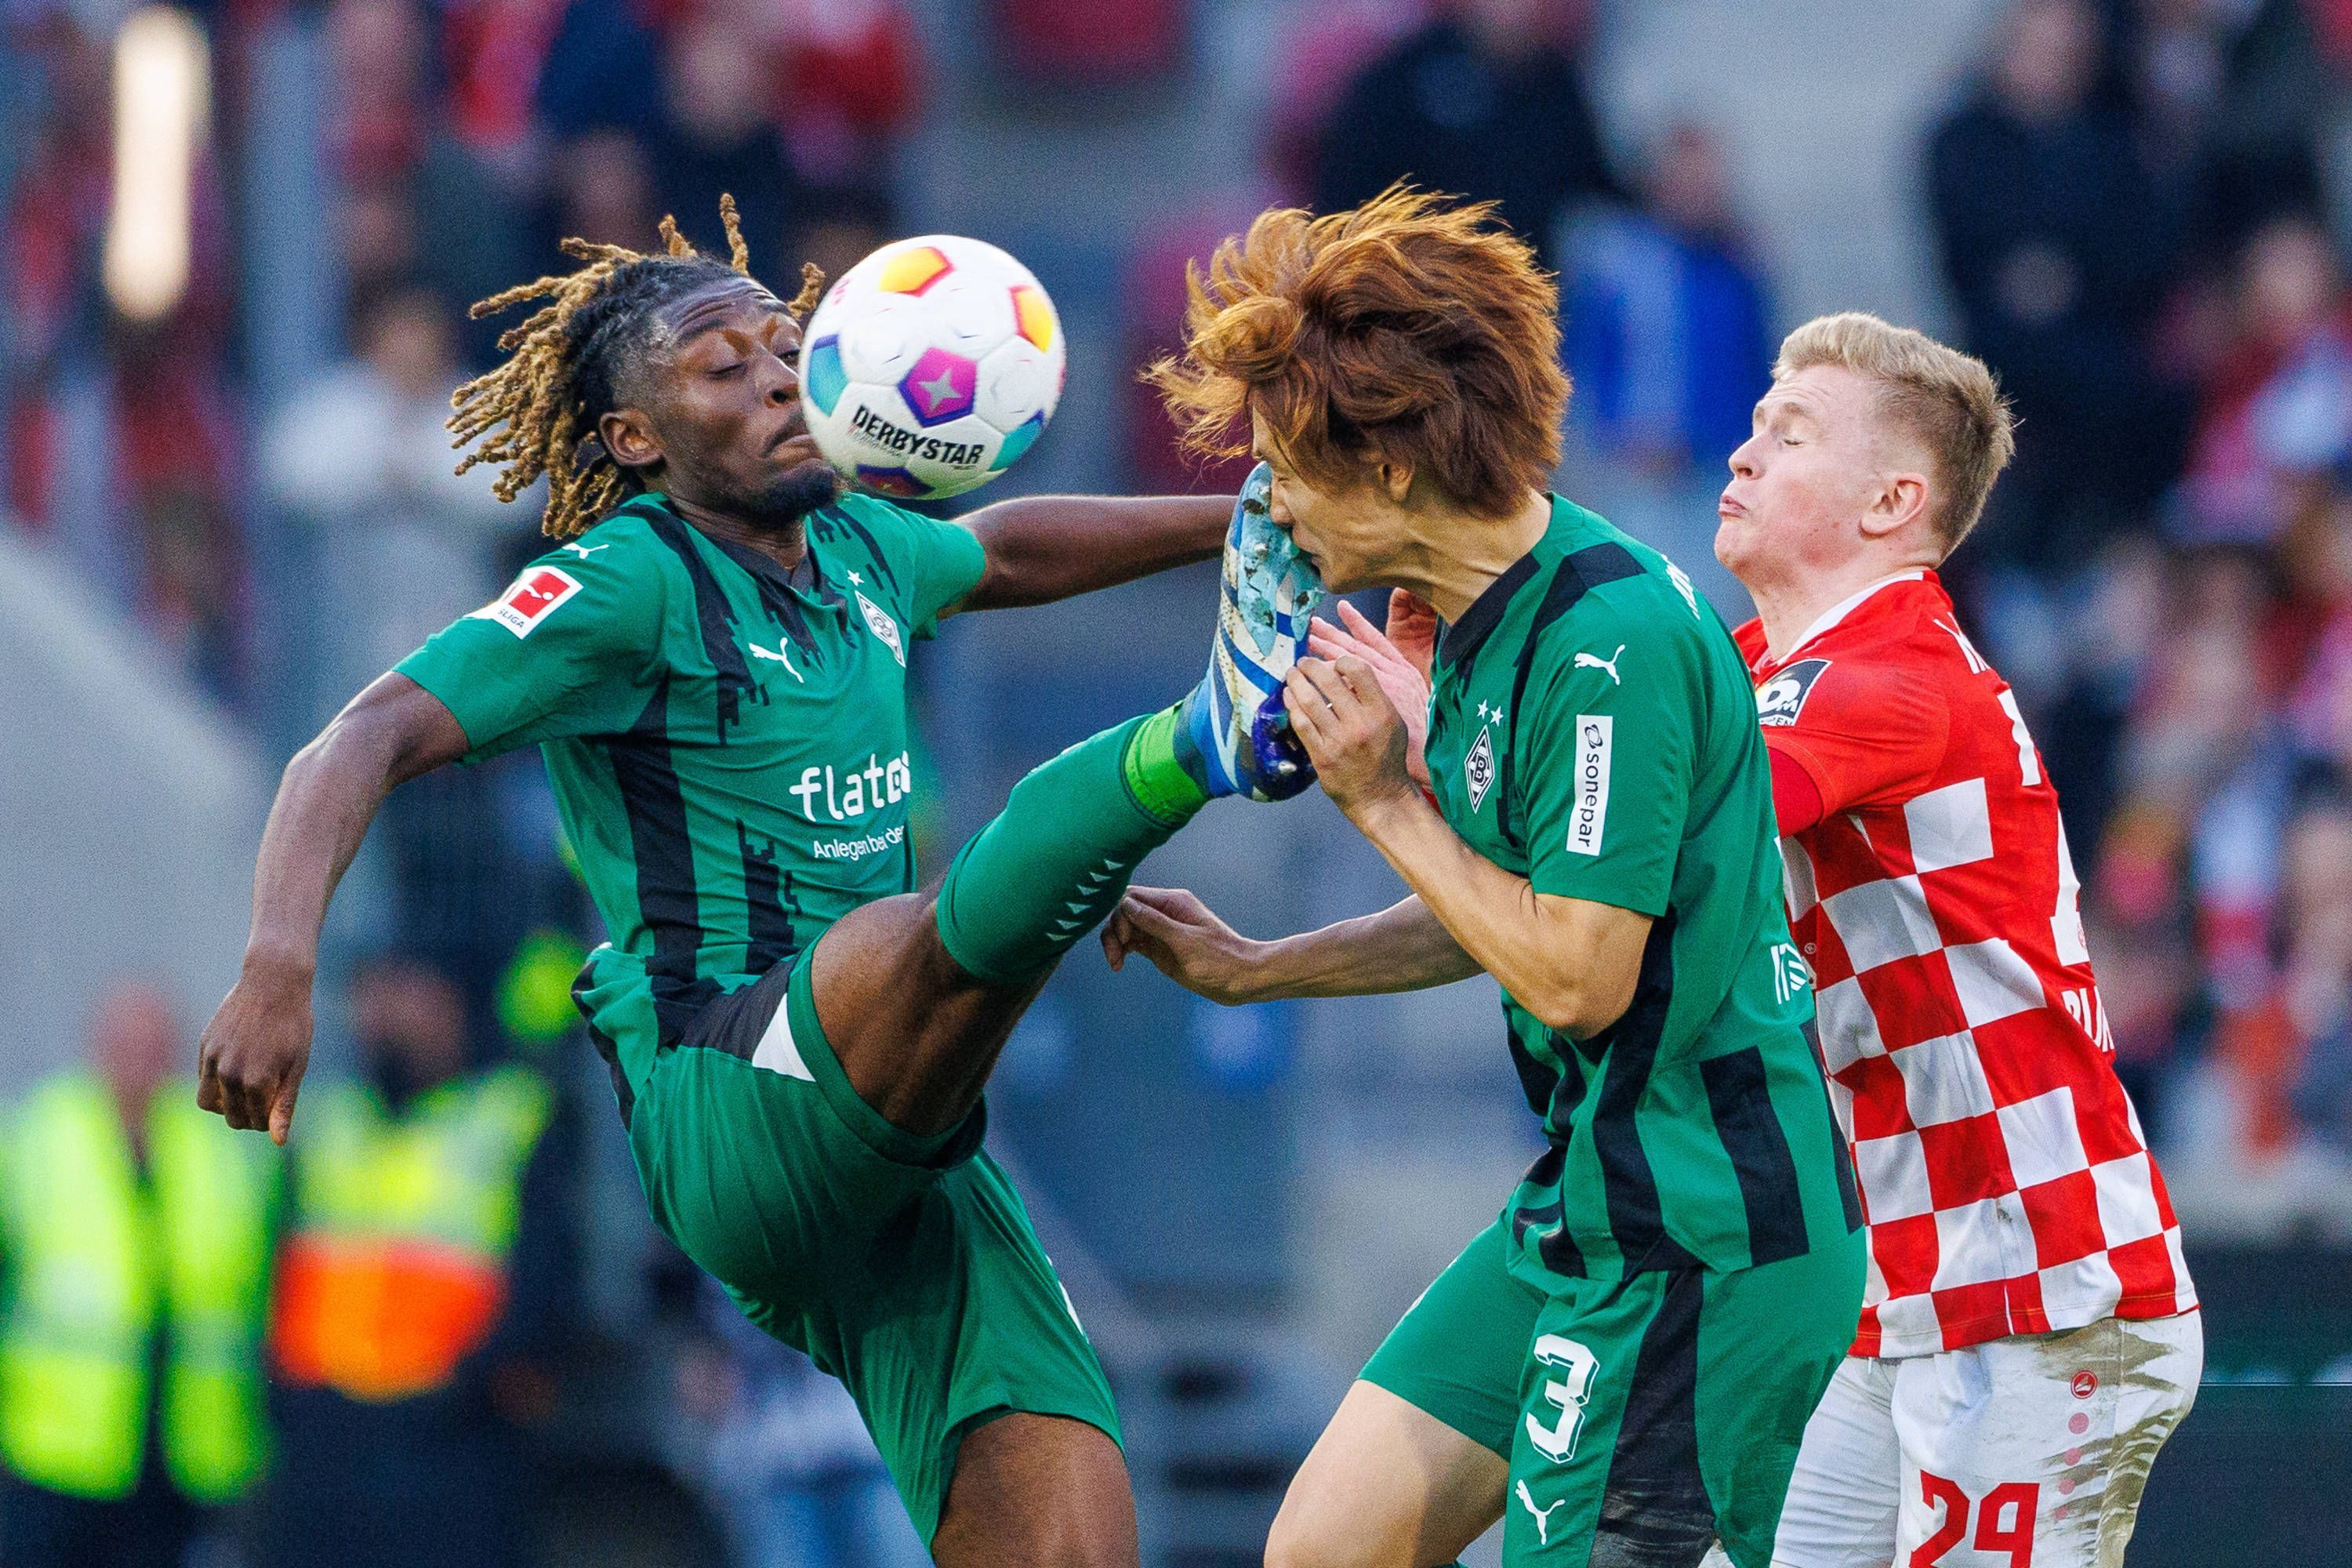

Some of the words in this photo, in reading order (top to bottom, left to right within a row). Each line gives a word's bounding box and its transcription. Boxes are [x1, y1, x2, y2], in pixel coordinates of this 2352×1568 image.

[852, 403, 985, 465] DERBYSTAR
[1578, 752, 1600, 848] sonepar
[813, 838, 871, 861] Anlegen
[1525, 1333, 1601, 1465] 3
[1907, 1468, 2041, 1568] 29
